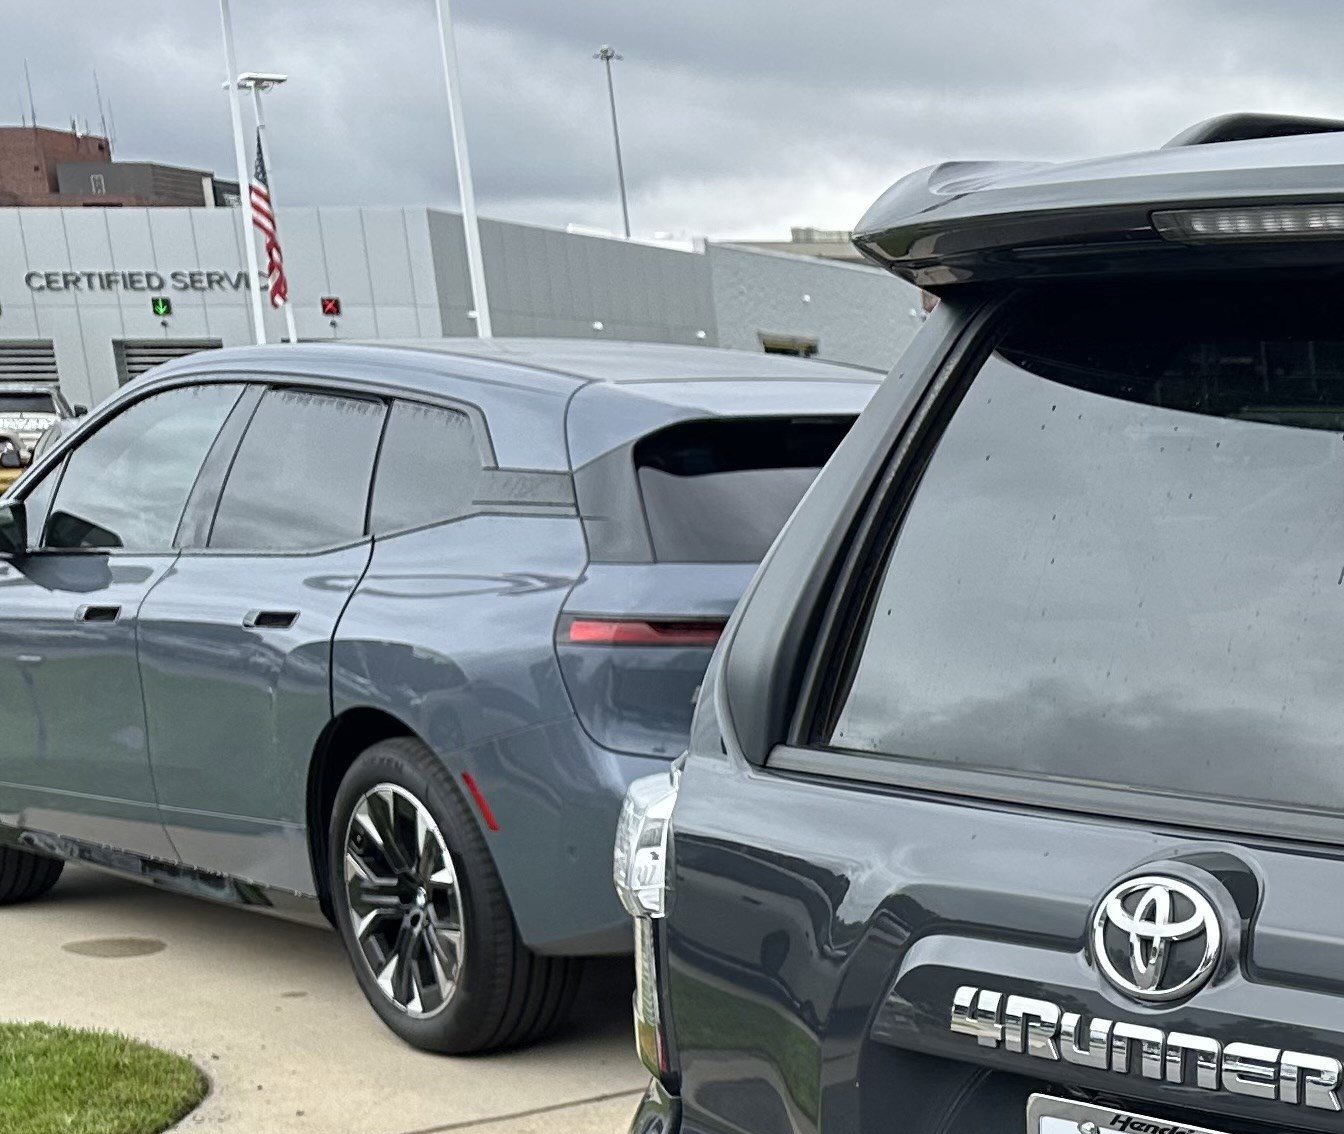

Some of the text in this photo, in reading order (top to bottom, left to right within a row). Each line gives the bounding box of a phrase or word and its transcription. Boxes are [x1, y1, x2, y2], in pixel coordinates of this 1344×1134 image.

[24, 270, 270, 292] CERTIFIED SERVIC
[950, 985, 1343, 1112] 4RUNNER
